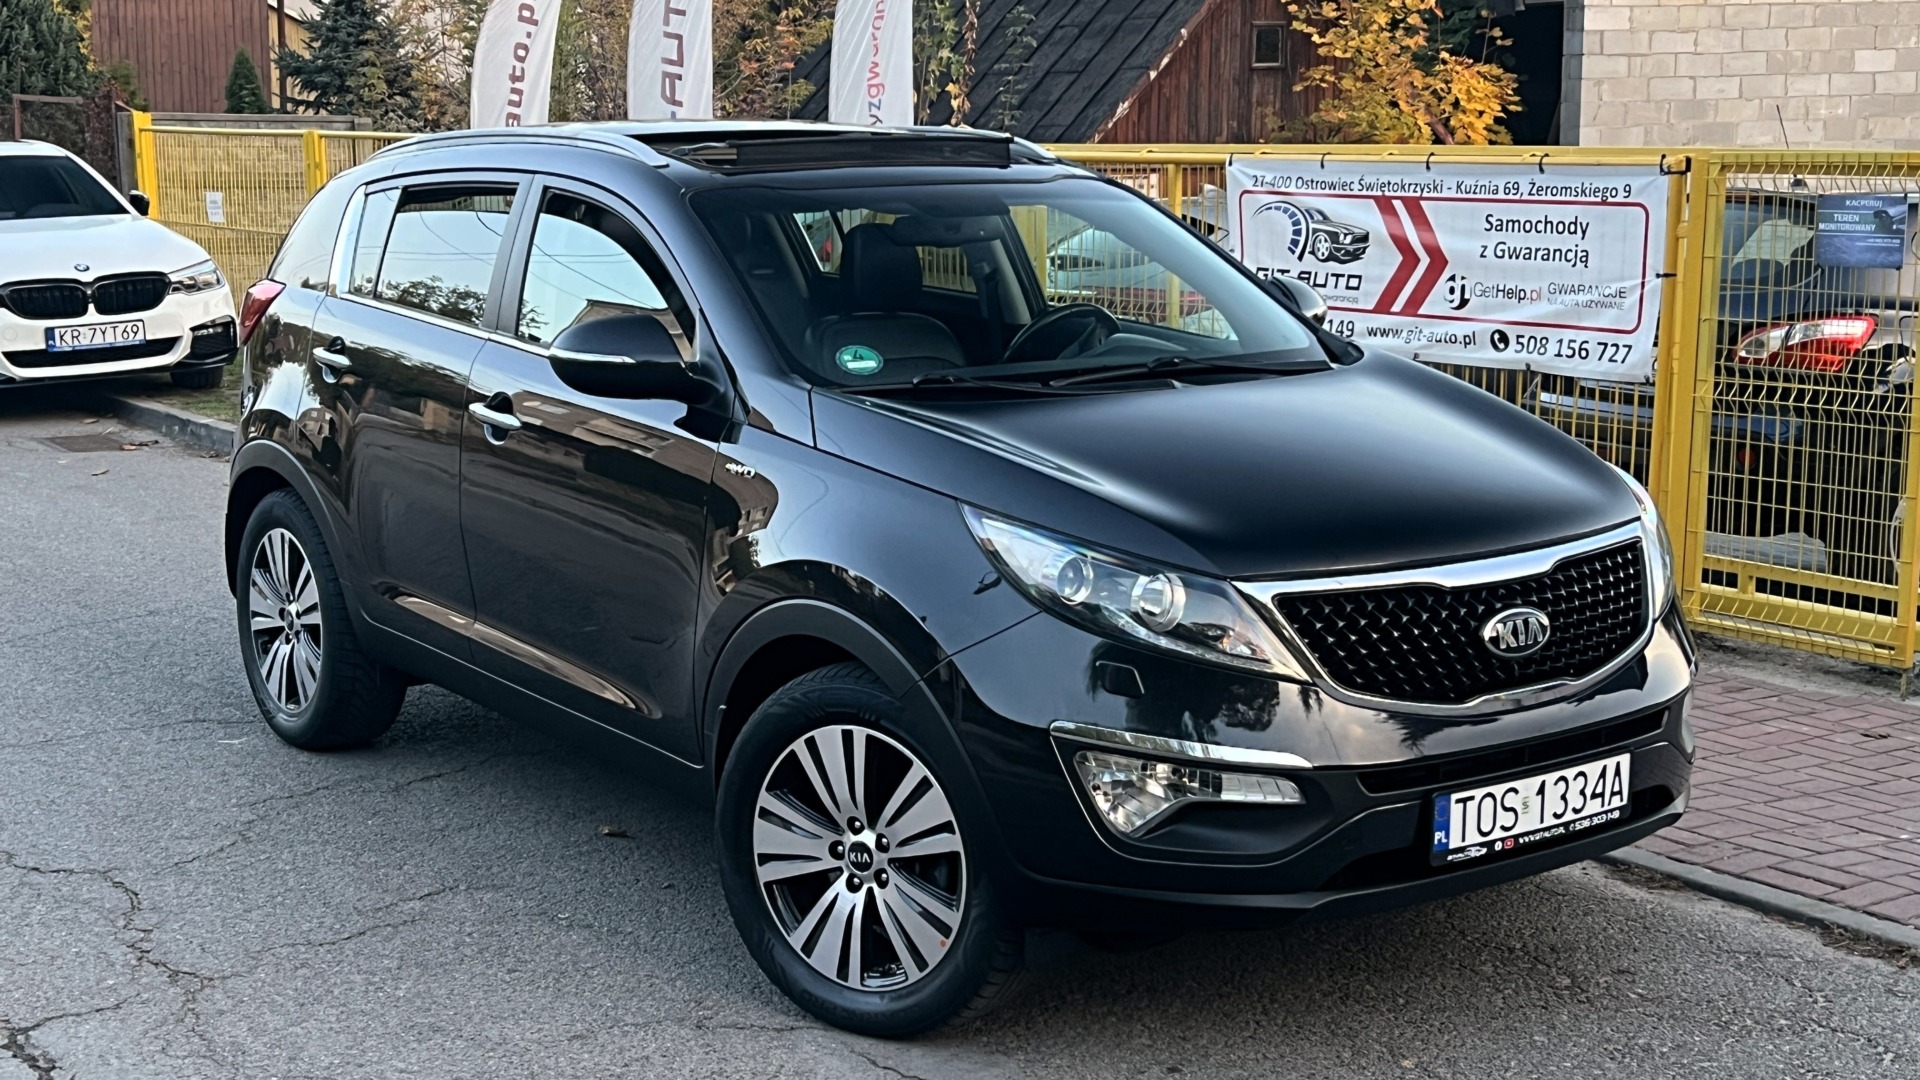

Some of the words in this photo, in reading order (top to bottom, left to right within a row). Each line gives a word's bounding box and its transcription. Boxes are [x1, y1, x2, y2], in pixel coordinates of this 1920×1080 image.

[505, 0, 539, 127] auto.p
[1252, 174, 1292, 189] 27-400
[1295, 176, 1355, 192] Ostrowiec
[1358, 175, 1443, 197] Świętokrzyski
[1455, 179, 1499, 195] Kuźnia
[1503, 181, 1524, 198] 69,
[1528, 178, 1619, 202] Żeromskiego
[1623, 184, 1632, 199] 9
[1484, 213, 1590, 240] Samochody
[1818, 223, 1876, 231] MONITOROWANY
[1833, 214, 1859, 222] TEREN
[1479, 244, 1488, 259] z
[1493, 241, 1590, 268] Gwarancją
[1473, 281, 1542, 304] GetHelp.pl
[1547, 281, 1628, 299] GWARANCJE
[58, 328, 82, 346] KR
[88, 323, 140, 344] 7YT69
[1366, 325, 1477, 349] www.git-auto.pl
[1514, 334, 1549, 356] 508
[1554, 338, 1590, 360] 156
[1597, 342, 1633, 365] 727
[1496, 617, 1543, 649] KIA
[1454, 786, 1520, 843] TOS
[1535, 760, 1624, 825] 1334A
[850, 852, 870, 863] KIA
